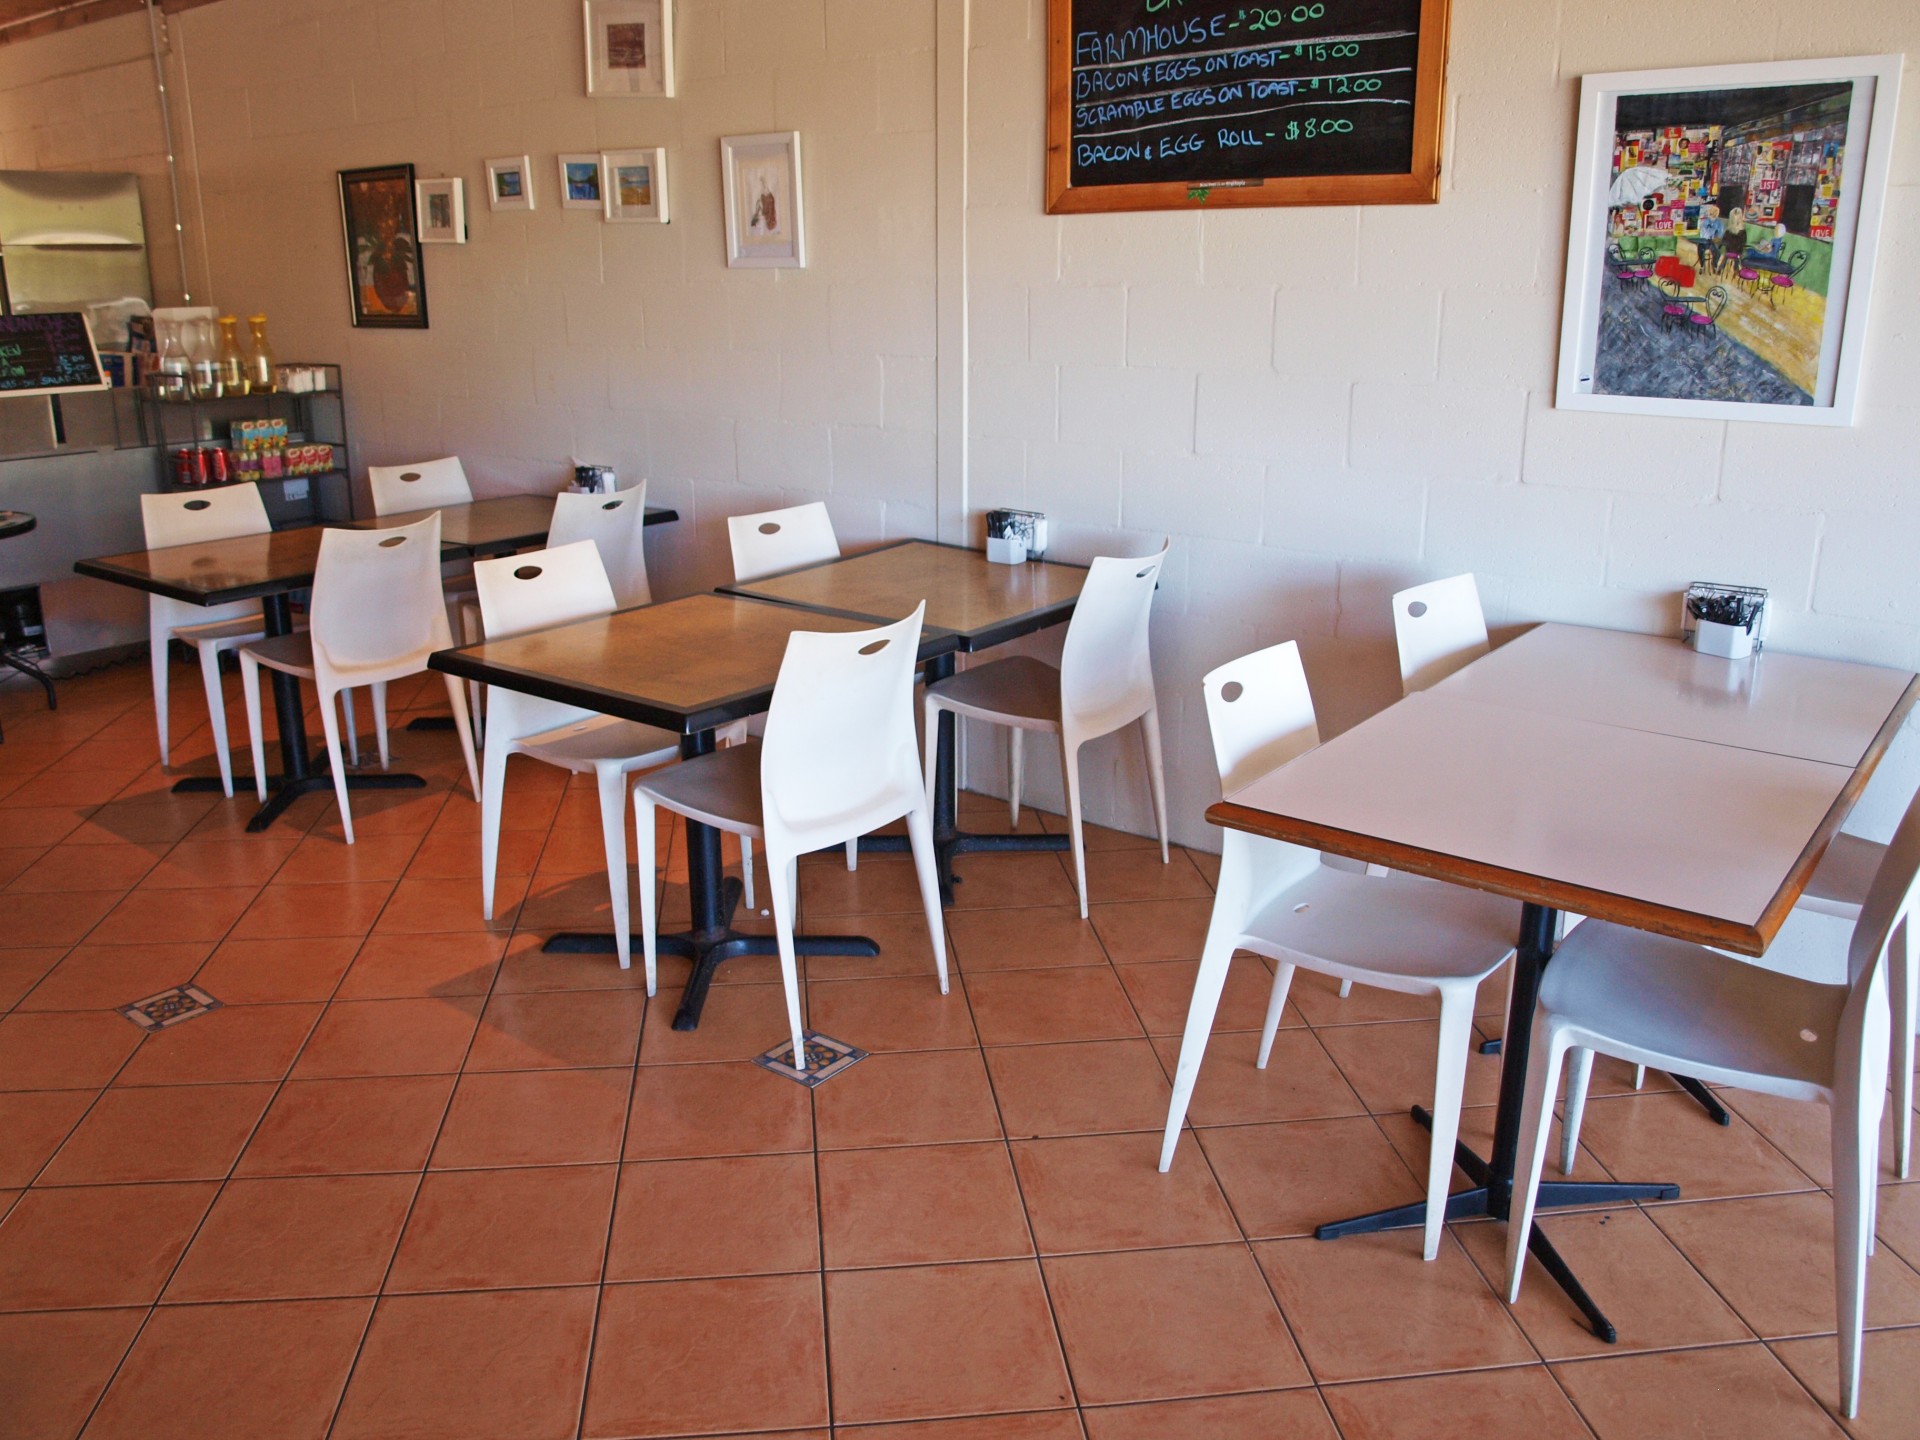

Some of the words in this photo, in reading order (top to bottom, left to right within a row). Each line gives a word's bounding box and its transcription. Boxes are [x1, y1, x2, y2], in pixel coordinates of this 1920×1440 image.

[1076, 14, 1226, 65] FARMHOUSE
[1076, 67, 1139, 100] BACON
[1155, 57, 1201, 83] EGGS
[1205, 54, 1228, 73] ON
[1076, 97, 1165, 128] SCRAMBLE
[1171, 88, 1216, 110] EGGS
[1218, 84, 1242, 104] ON
[1077, 141, 1140, 167] BACON
[1160, 133, 1205, 159] EGG
[1217, 127, 1263, 149] ROLL
[1760, 181, 1775, 190] LIST
[1655, 220, 1673, 230] LOVE
[1810, 228, 1831, 238] LOVE
